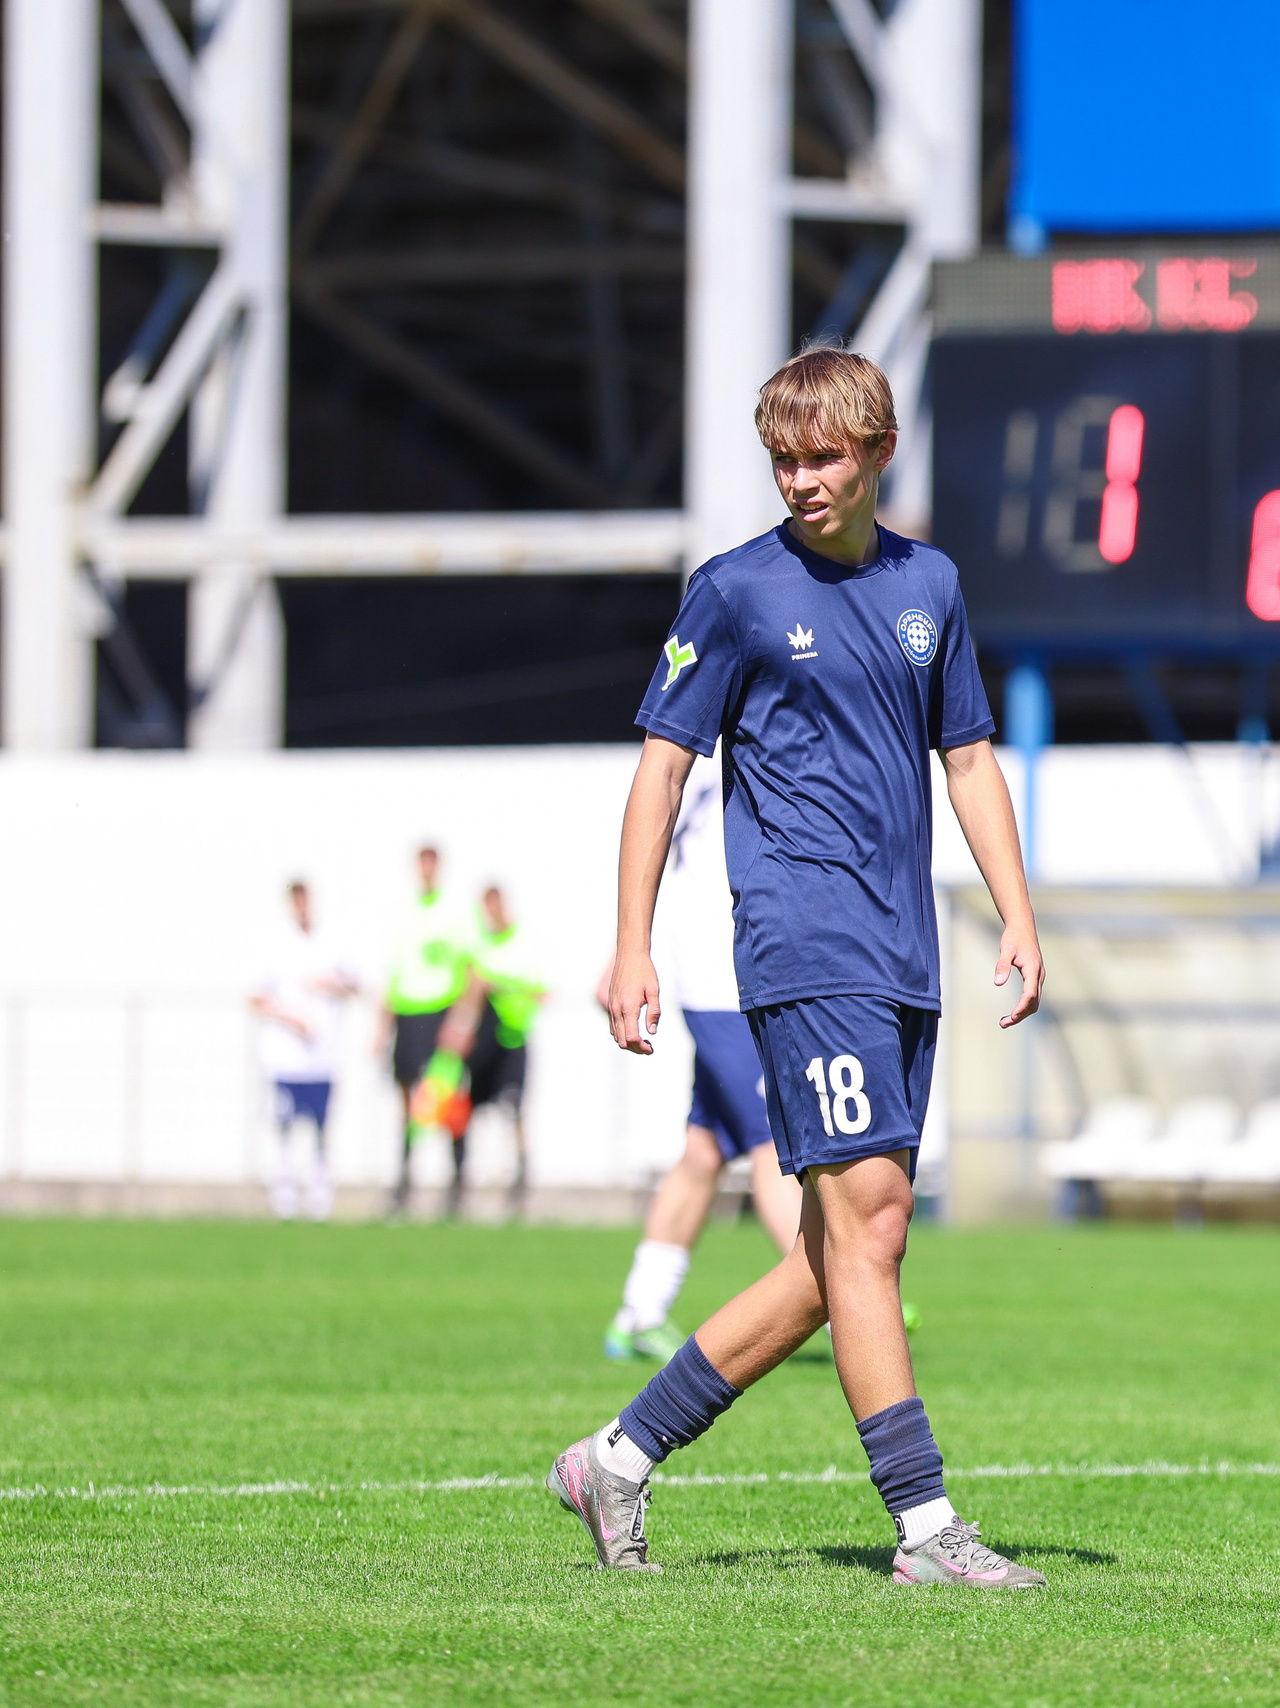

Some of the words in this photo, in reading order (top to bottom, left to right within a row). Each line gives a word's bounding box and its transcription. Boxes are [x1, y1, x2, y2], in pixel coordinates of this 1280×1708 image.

[1099, 404, 1145, 566] 1
[900, 613, 936, 637] ОРЕНБУРГ
[805, 1054, 872, 1137] 18
